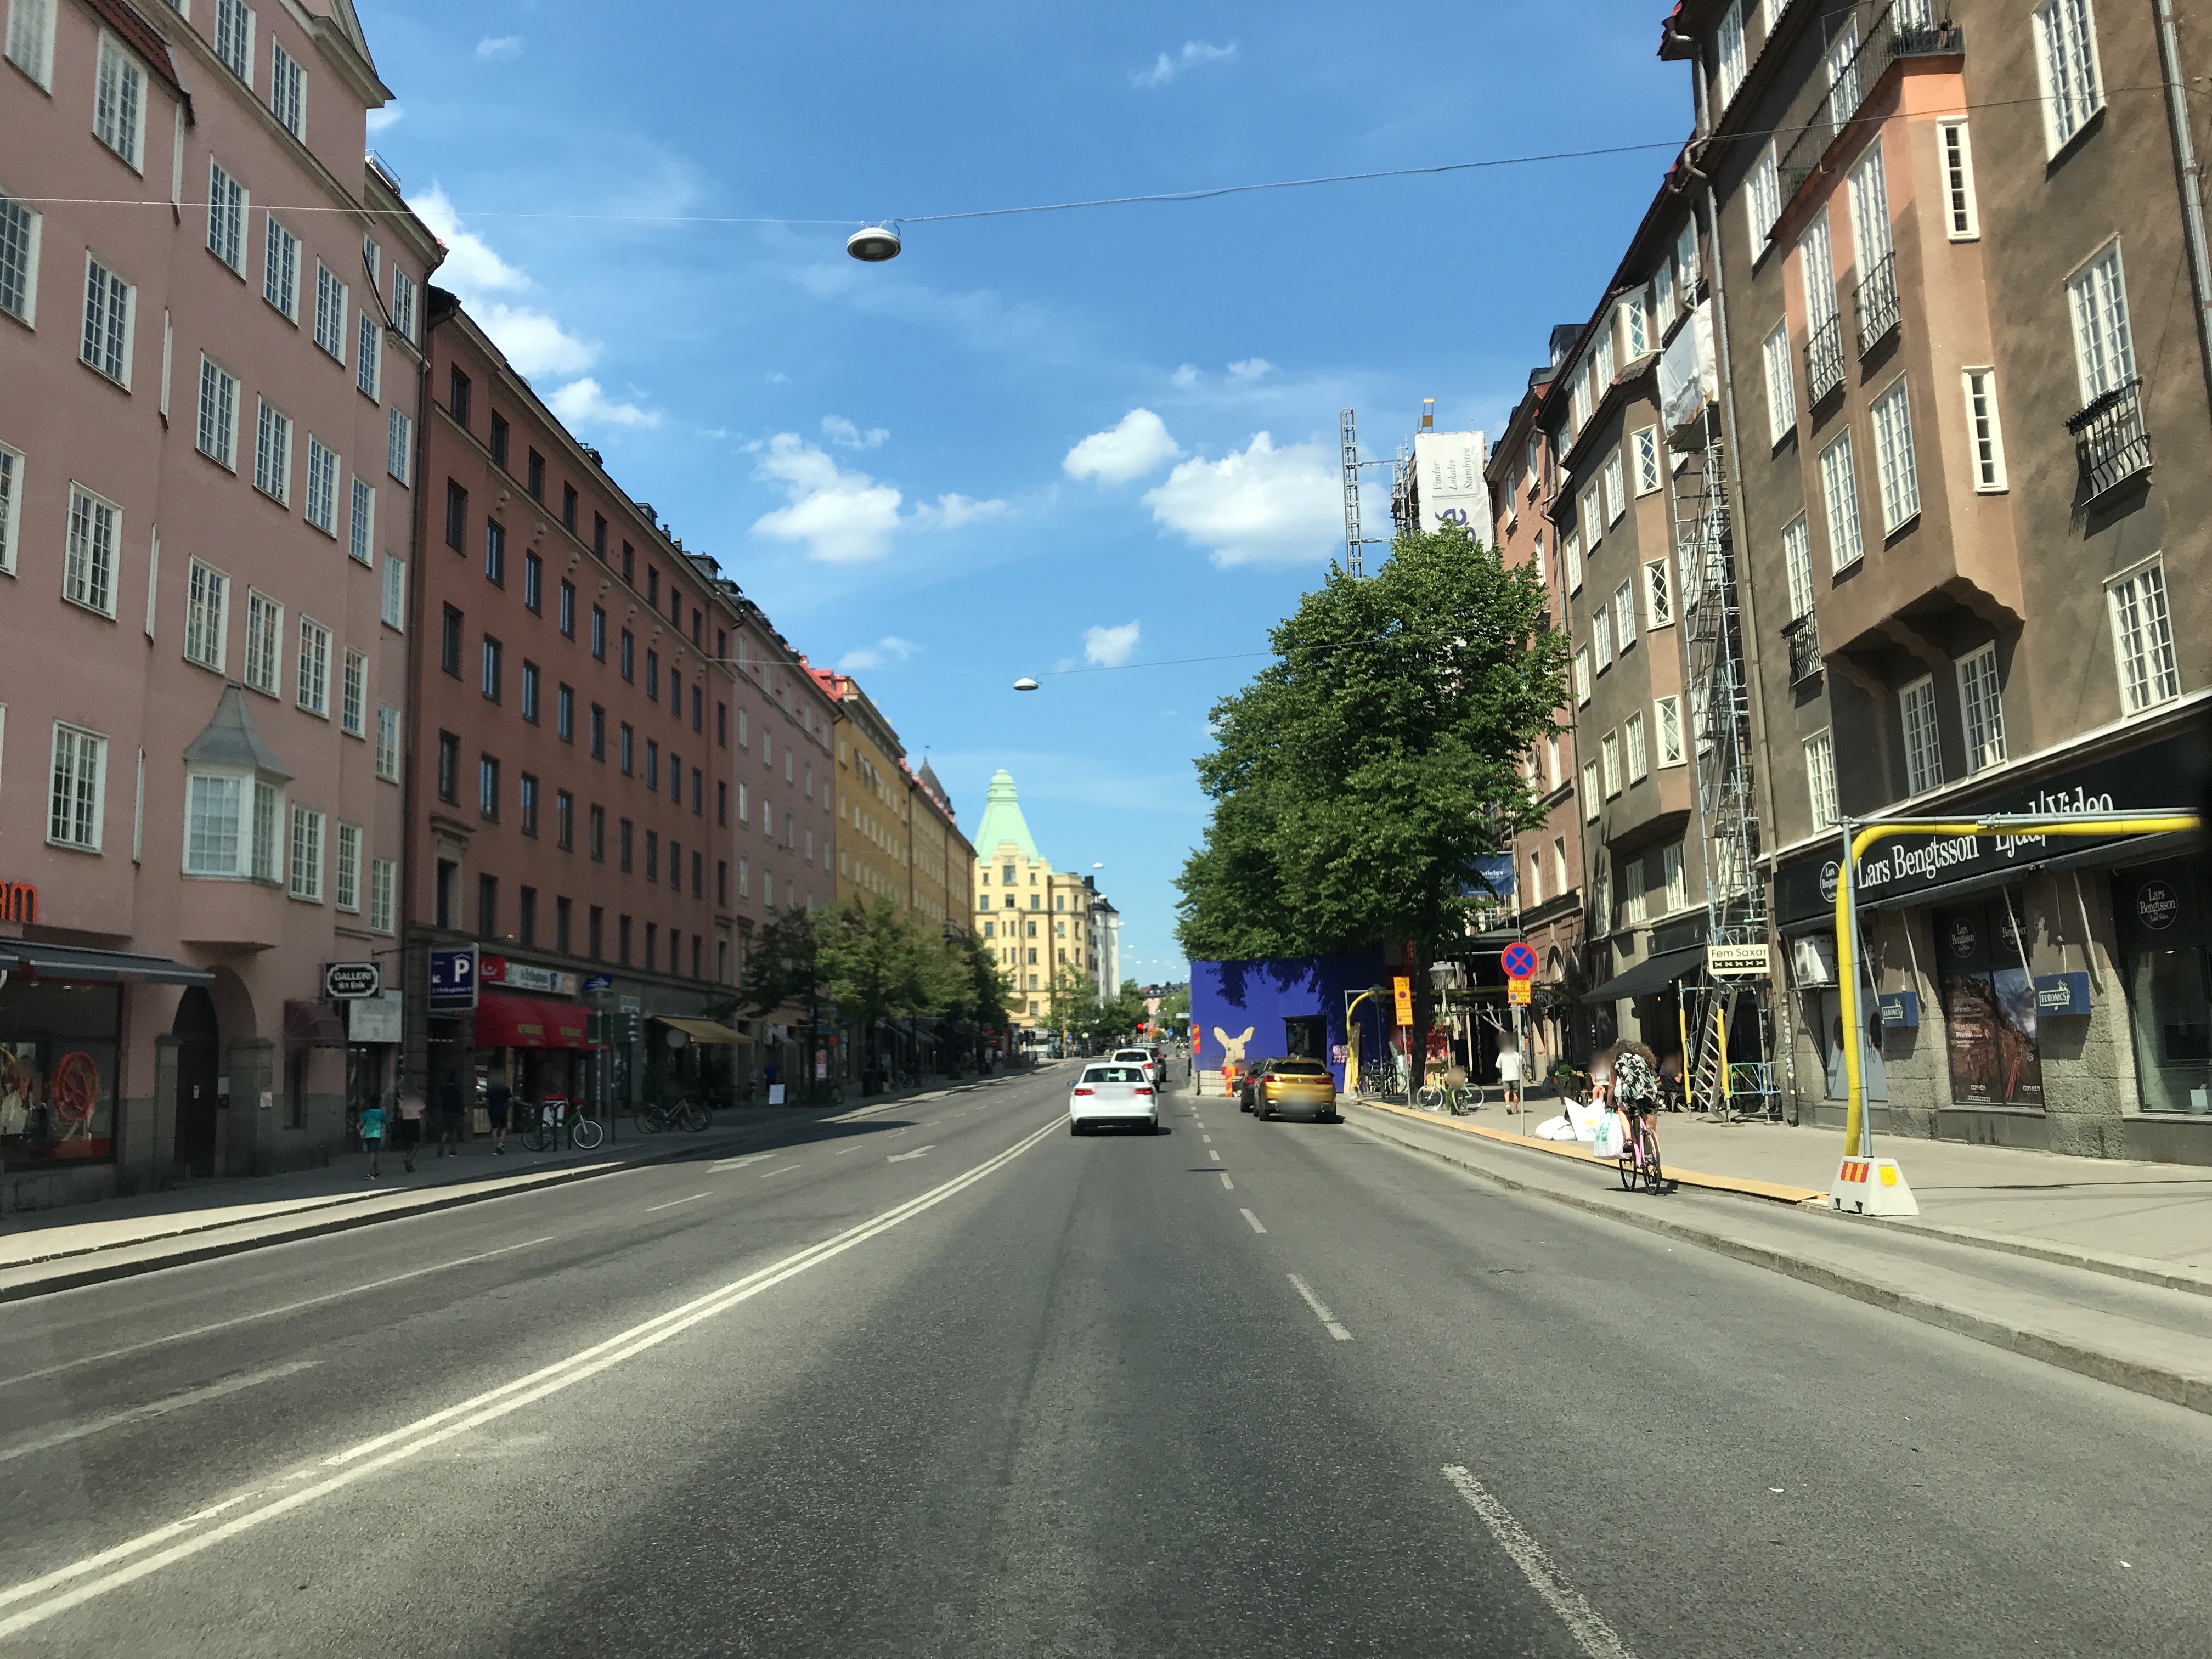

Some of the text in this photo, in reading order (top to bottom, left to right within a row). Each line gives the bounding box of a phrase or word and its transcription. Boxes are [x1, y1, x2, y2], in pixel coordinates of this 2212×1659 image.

[1432, 462, 1442, 490] Vindar
[1447, 459, 1458, 490] Lokaler
[1463, 447, 1475, 489] Stambyten
[1857, 856, 1891, 889] Lars
[1892, 835, 1979, 879] Bengtsson
[2147, 888, 2165, 901] Lars
[2140, 900, 2176, 915] Bengtsson
[1711, 948, 1767, 958] Fem Saxar
[454, 958, 470, 983] P
[2041, 992, 2067, 1003] EURONICS
